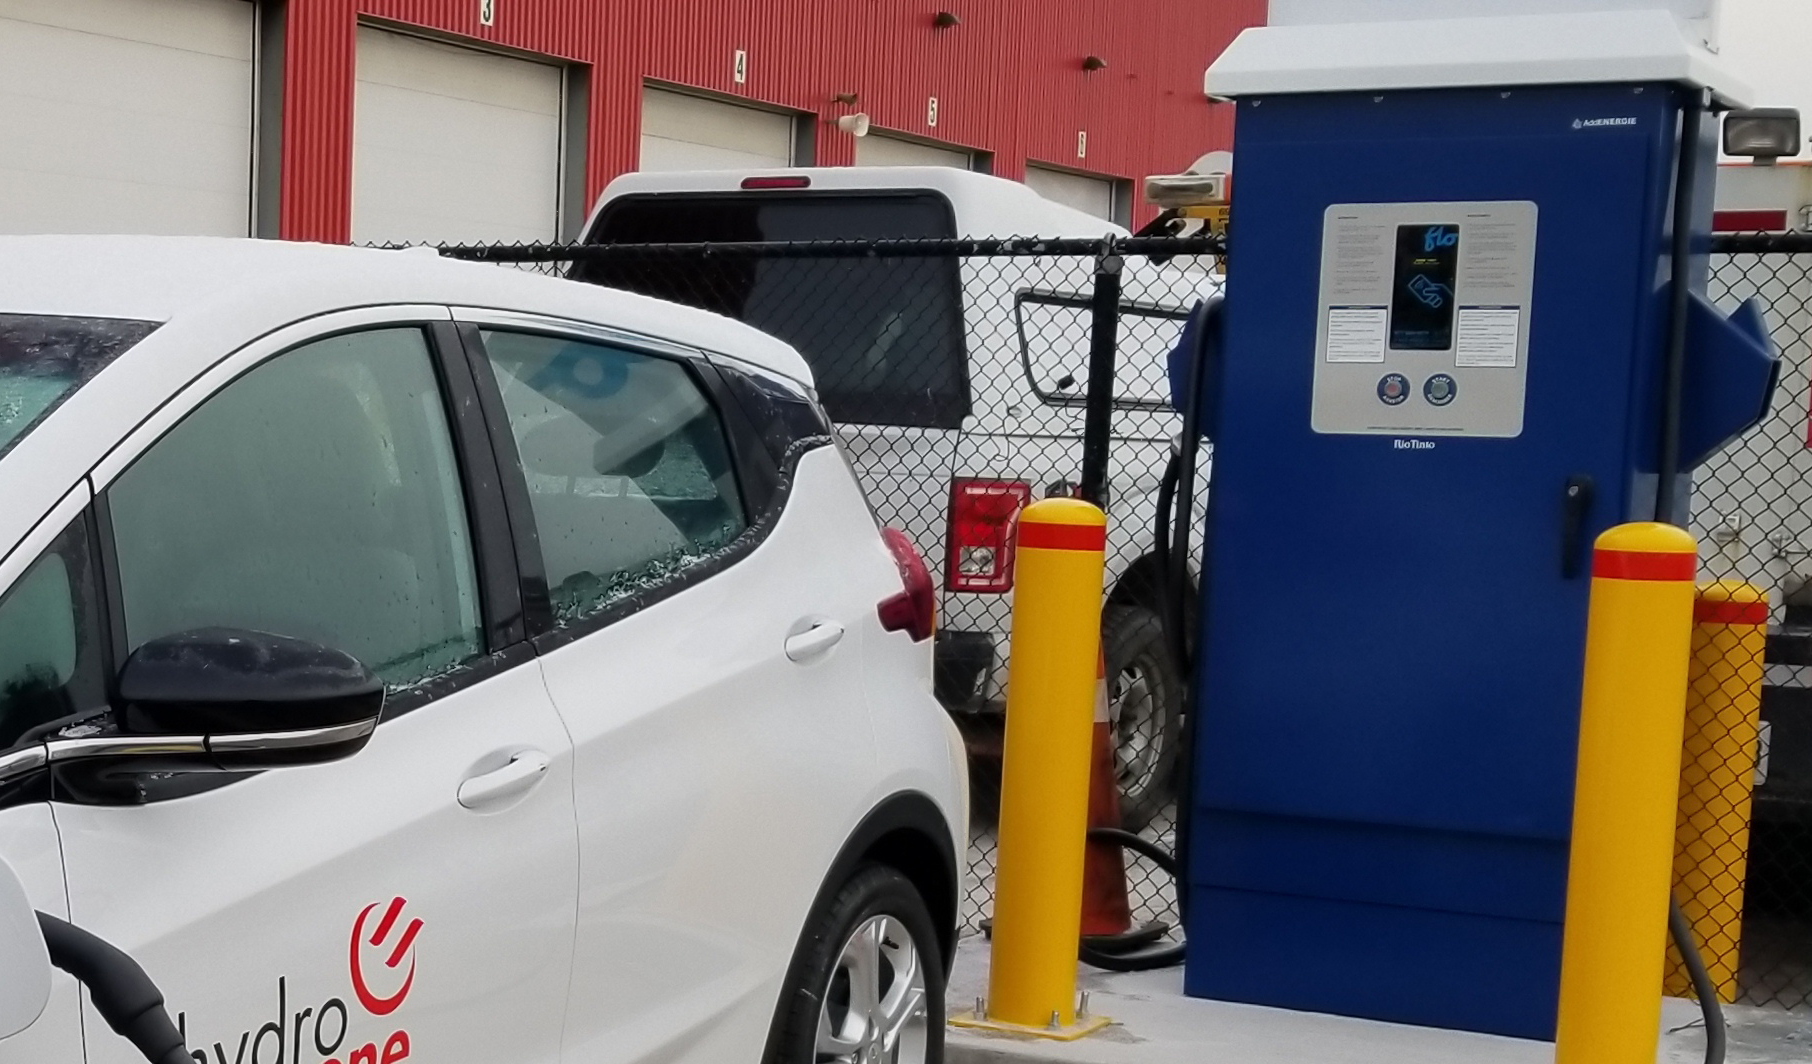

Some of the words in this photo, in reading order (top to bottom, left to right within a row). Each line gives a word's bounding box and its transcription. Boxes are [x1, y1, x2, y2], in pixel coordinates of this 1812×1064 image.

[736, 53, 744, 81] 4
[930, 99, 936, 124] 5
[1424, 226, 1458, 251] flo
